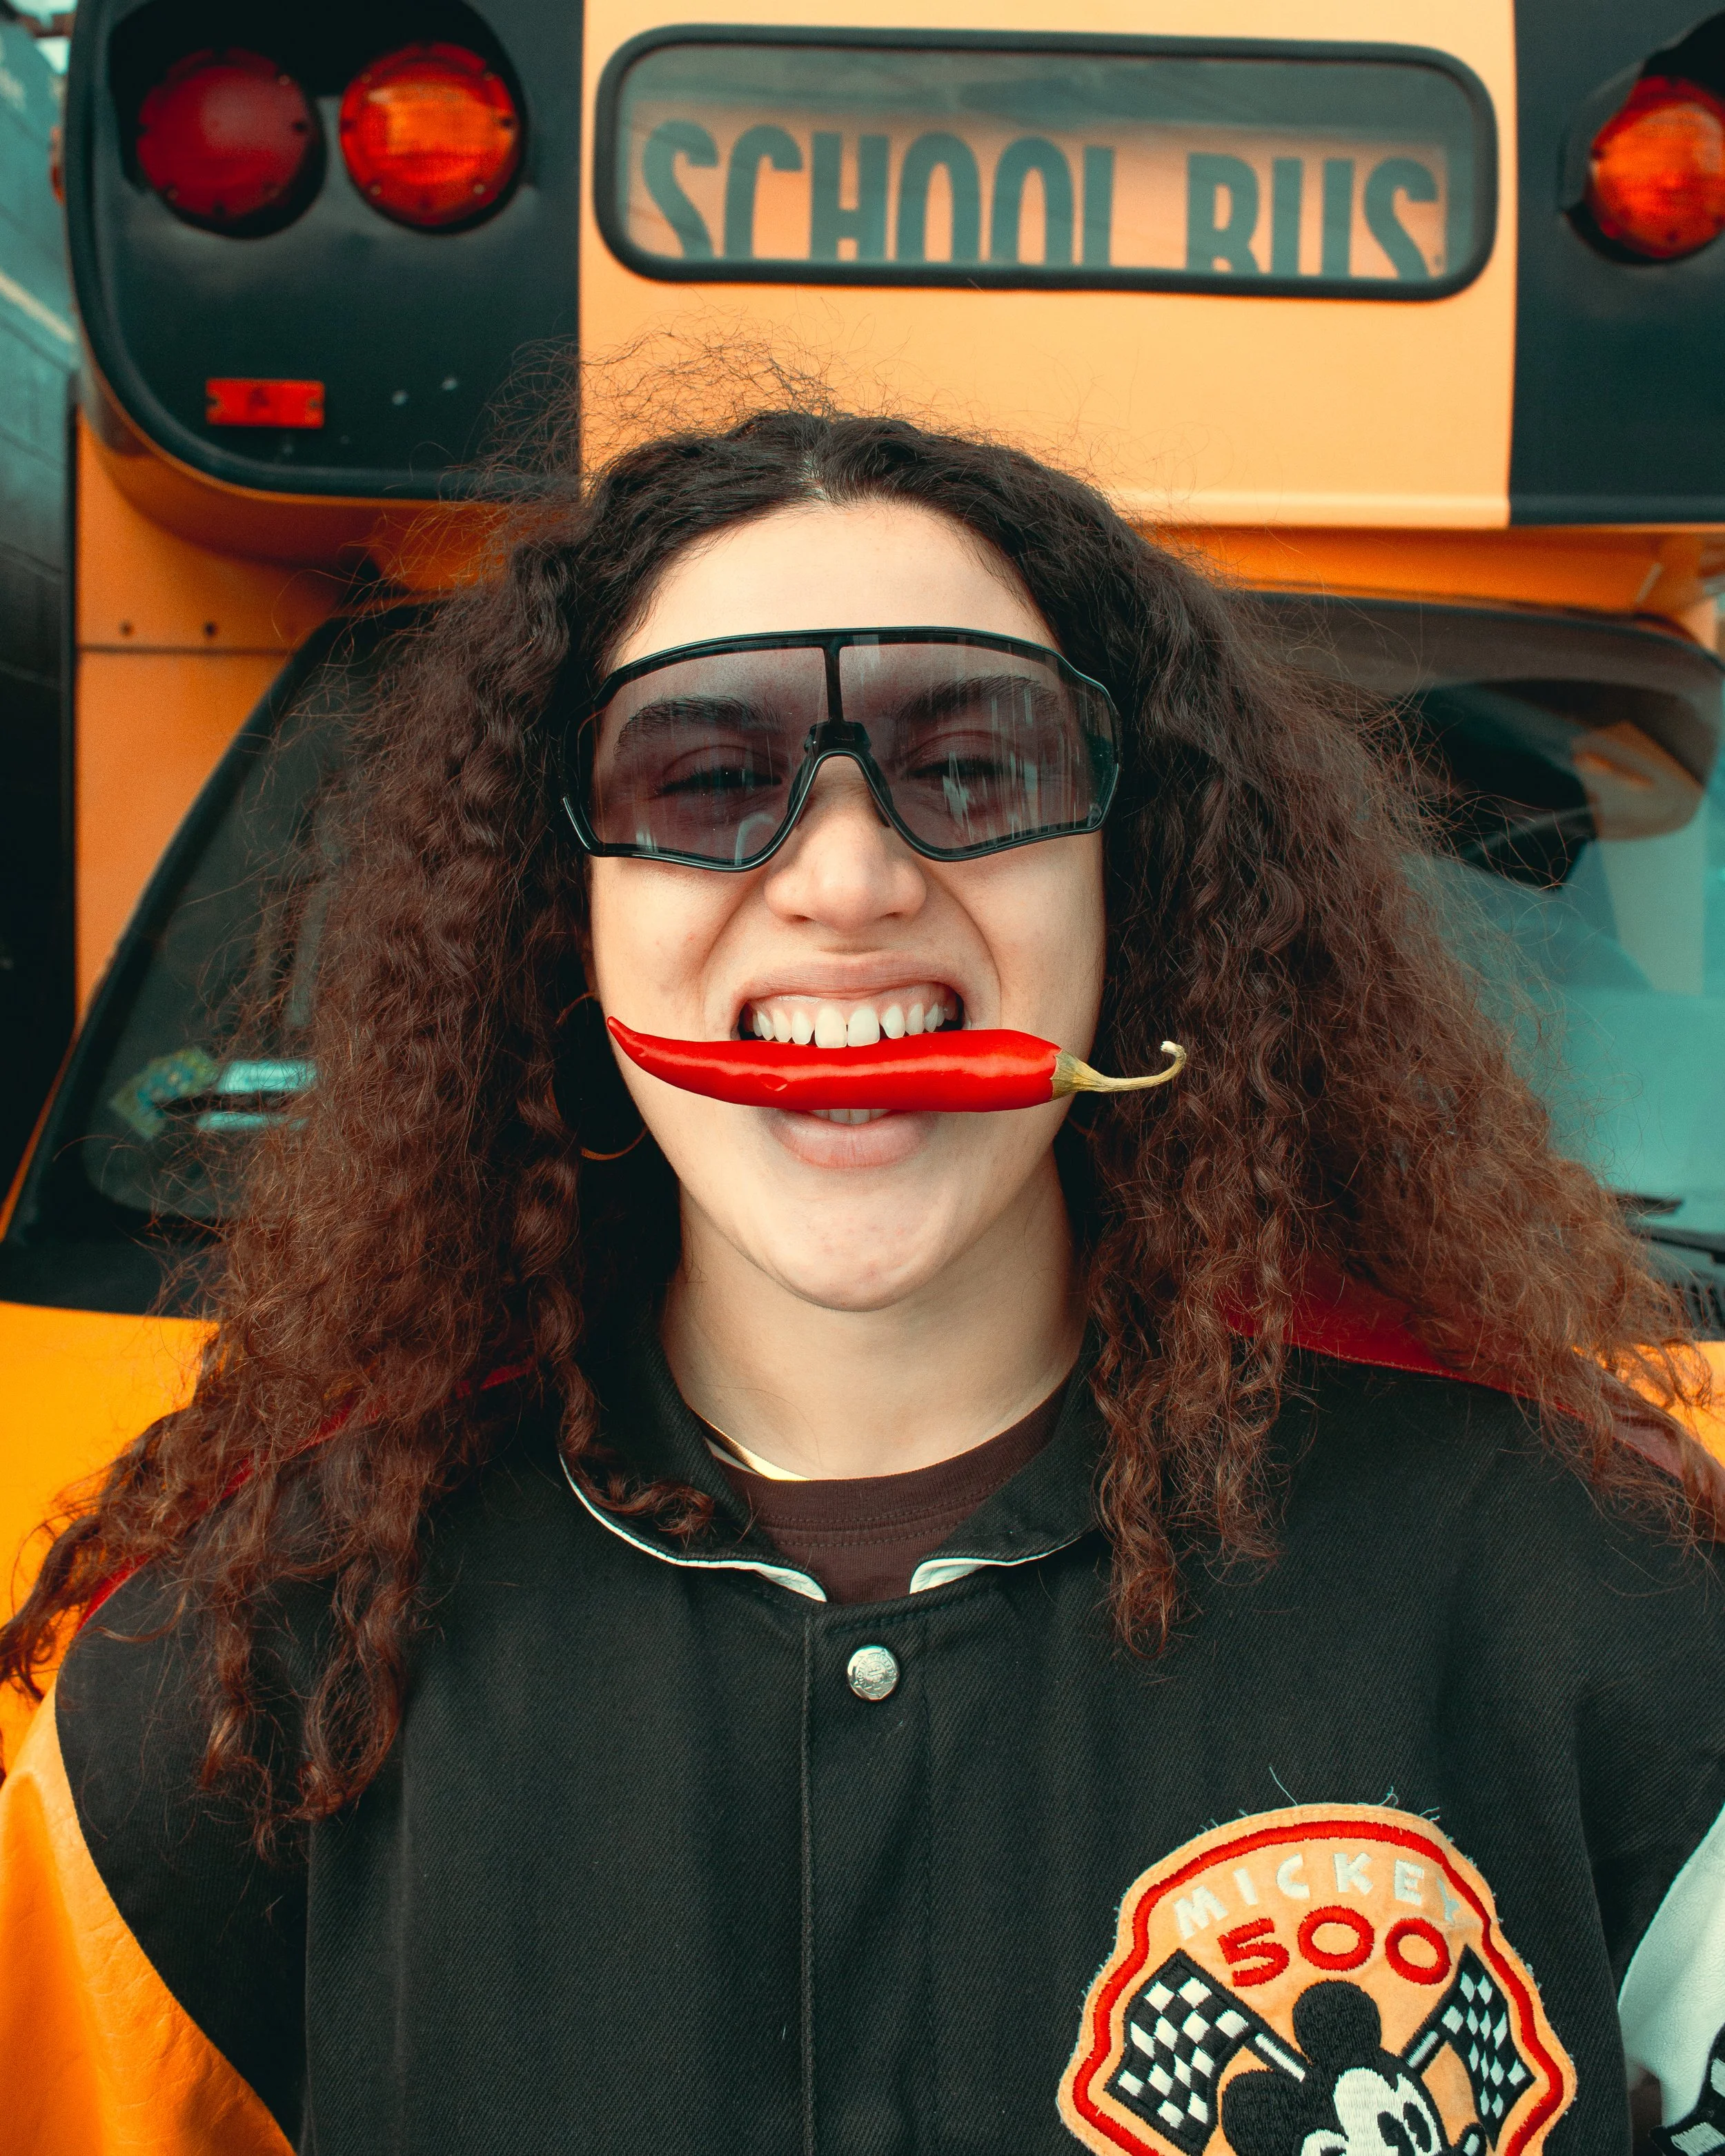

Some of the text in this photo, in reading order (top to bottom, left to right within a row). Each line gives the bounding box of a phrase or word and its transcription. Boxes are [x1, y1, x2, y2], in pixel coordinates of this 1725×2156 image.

[642, 120, 1438, 279] SCHOOL BUS
[1173, 1852, 1460, 1940] MICKEY
[1218, 1905, 1451, 1987] 500
